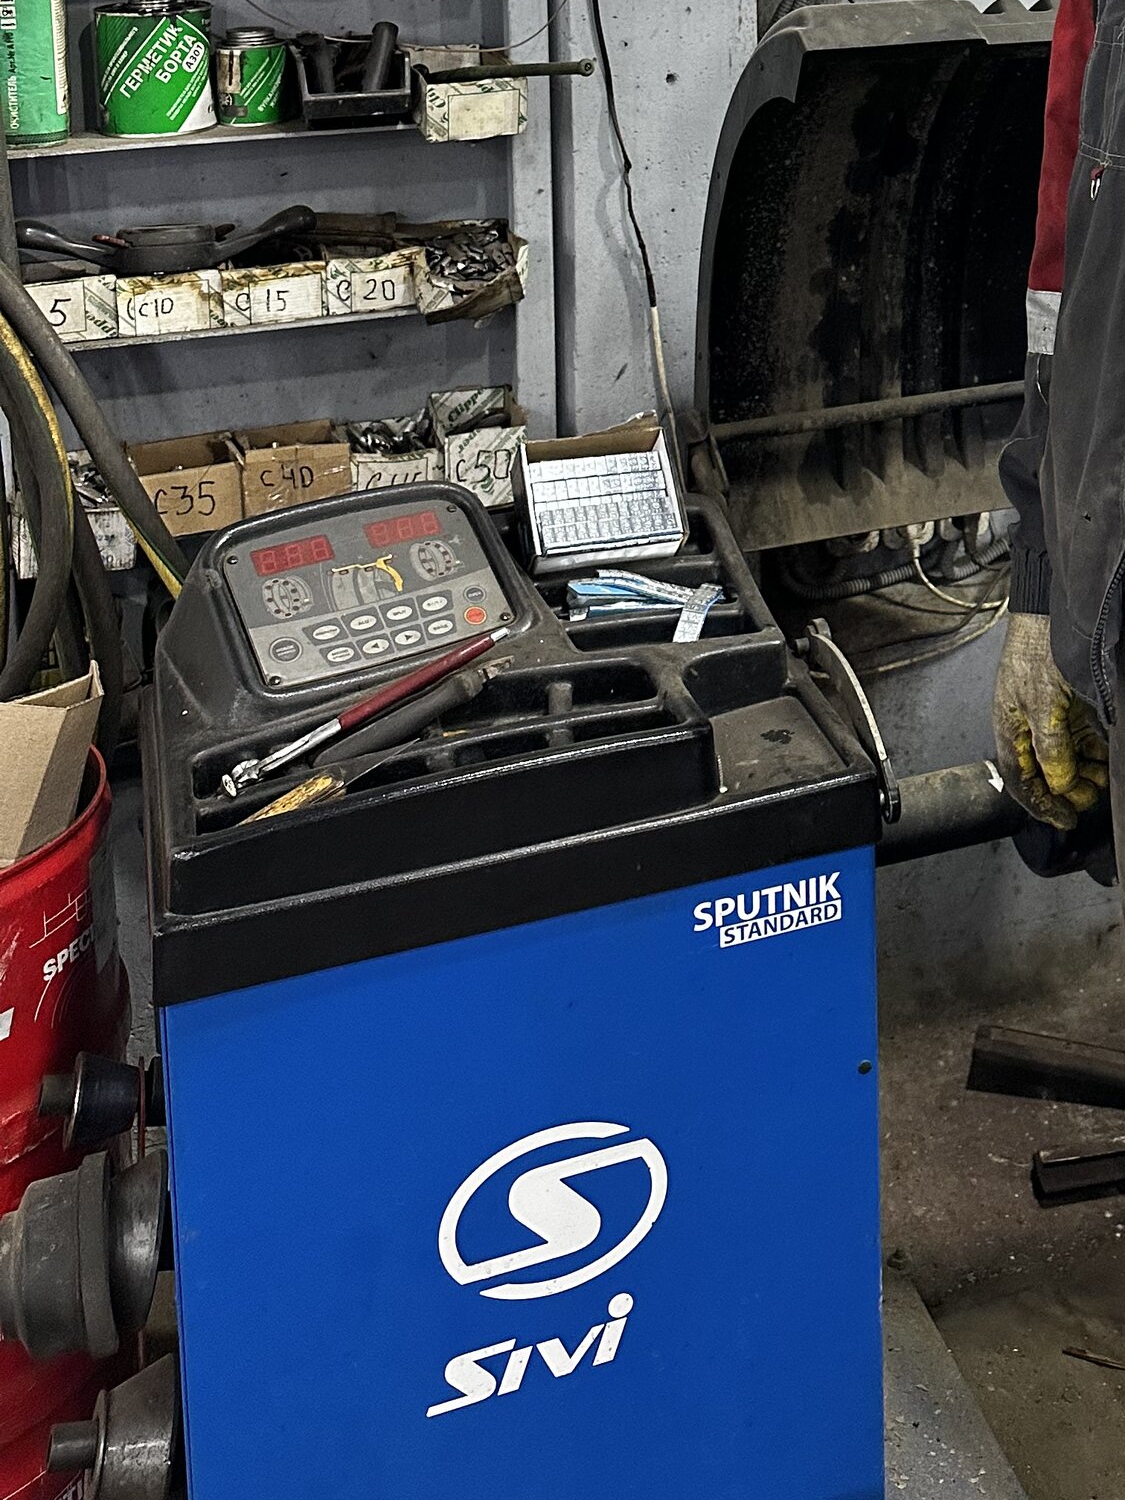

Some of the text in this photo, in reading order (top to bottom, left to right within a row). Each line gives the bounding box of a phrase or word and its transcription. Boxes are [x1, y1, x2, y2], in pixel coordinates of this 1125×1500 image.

[119, 24, 184, 99] ГЕРМЕТИК
[154, 34, 198, 84] БОРТА
[8, 76, 19, 130] ОЧИСТИТЕЛЬ
[693, 871, 841, 932] SPUTNIK
[723, 902, 838, 945] STANDARD
